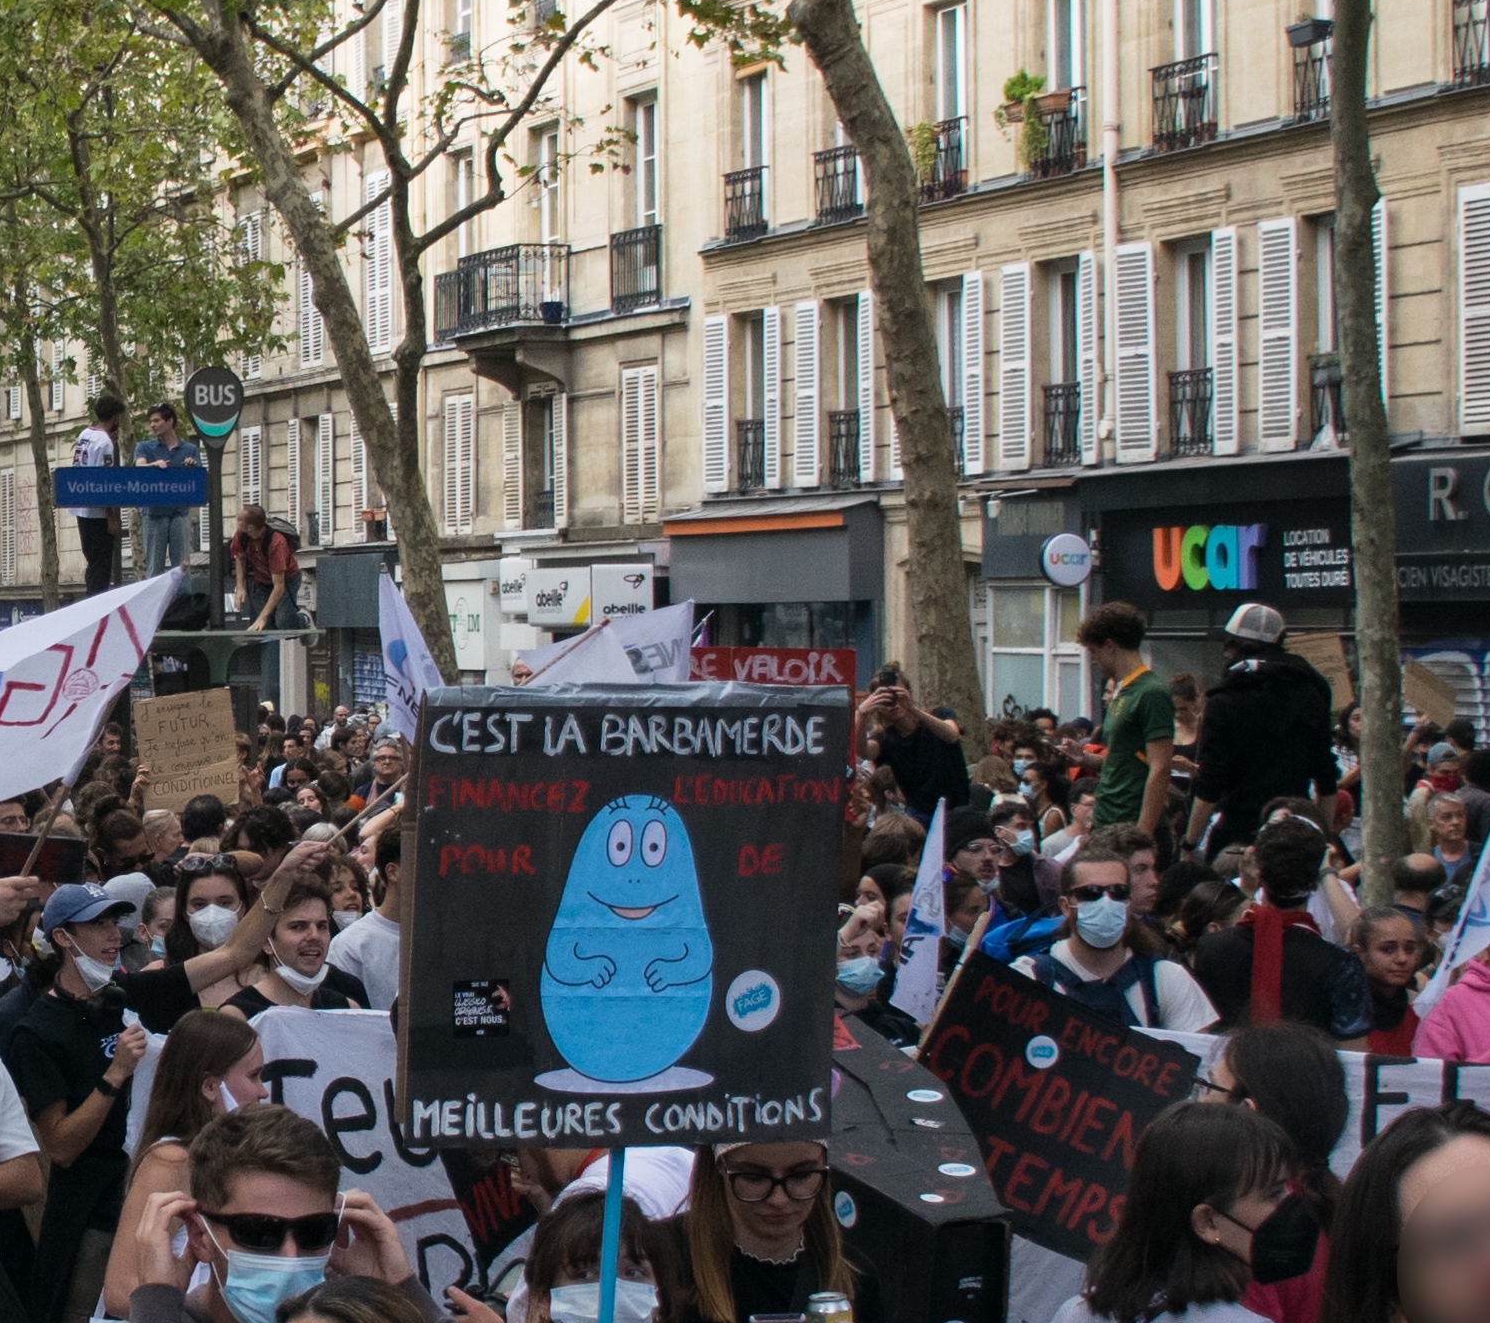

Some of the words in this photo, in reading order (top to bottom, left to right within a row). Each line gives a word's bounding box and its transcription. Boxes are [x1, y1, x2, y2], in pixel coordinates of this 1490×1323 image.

[195, 384, 236, 406] BUS
[67, 480, 197, 495] Voltaire-Montreuil
[1283, 529, 1330, 545] LOCATION
[1049, 553, 1087, 566] ucar
[1153, 523, 1268, 591] ucar
[1284, 550, 1298, 567] DE
[1301, 546, 1349, 567] VÉHICULES
[502, 581, 523, 595] abeille
[1286, 571, 1320, 588] TOUTES
[536, 587, 563, 607] abeille
[603, 603, 647, 615] abeille
[429, 710, 532, 755] C'EST
[543, 713, 587, 757] LA
[600, 714, 828, 757] BARBAMERDE
[144, 738, 160, 758] Je
[165, 738, 196, 757] refuse
[153, 771, 238, 796] CONDITIONNEL
[427, 776, 592, 814] FINANCEZ
[438, 844, 536, 877] POUR
[738, 842, 784, 877] DE
[736, 988, 767, 1012] FAGE
[455, 1017, 479, 1026] C'EST
[974, 975, 1049, 1034] POUR
[1059, 1016, 1180, 1097] ENCORE
[926, 1026, 1136, 1169] COMBIEN
[985, 1136, 1122, 1245] TEMPS
